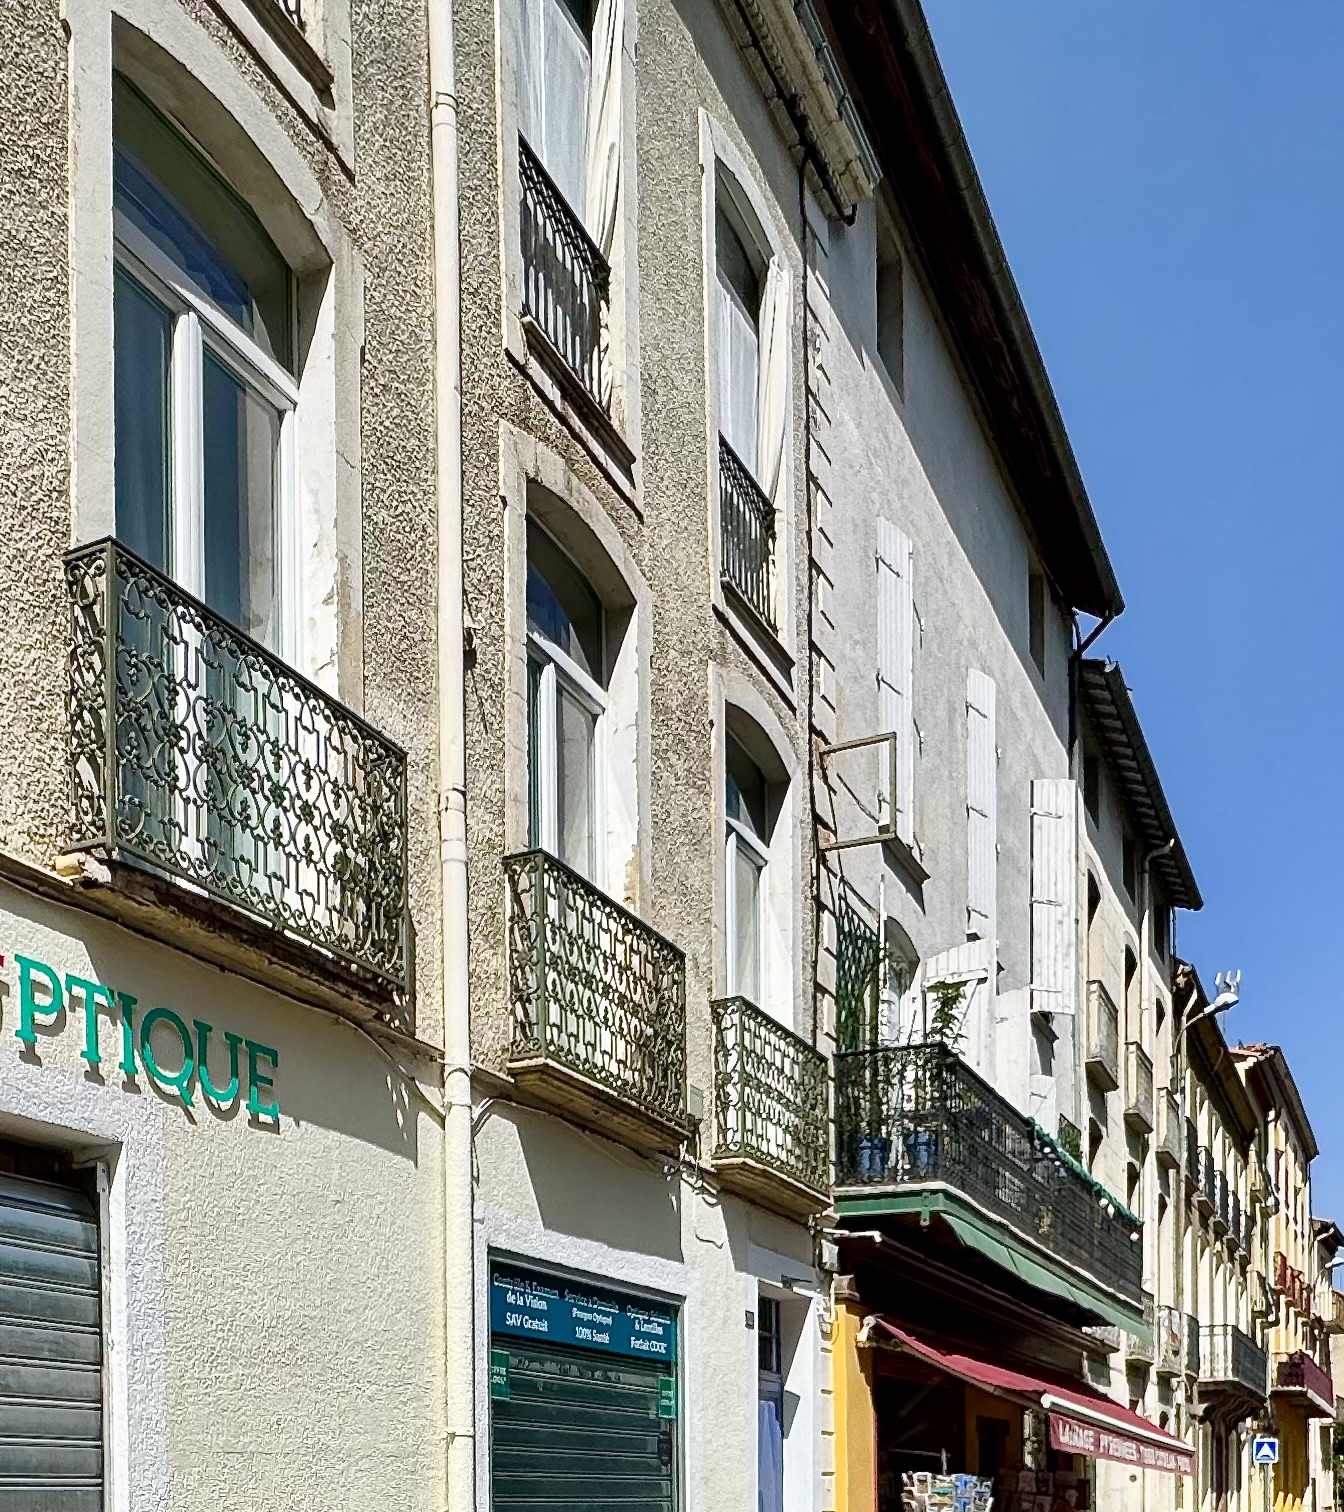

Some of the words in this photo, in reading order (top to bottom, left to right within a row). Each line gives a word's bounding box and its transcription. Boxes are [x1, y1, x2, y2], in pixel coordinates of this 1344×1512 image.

[506, 1290, 516, 1306] de
[516, 1292, 524, 1306] la
[524, 1294, 547, 1310] Vision
[505, 1311, 522, 1327] SAV
[522, 1315, 549, 1333] Gratuit
[575, 1326, 592, 1341] 100%
